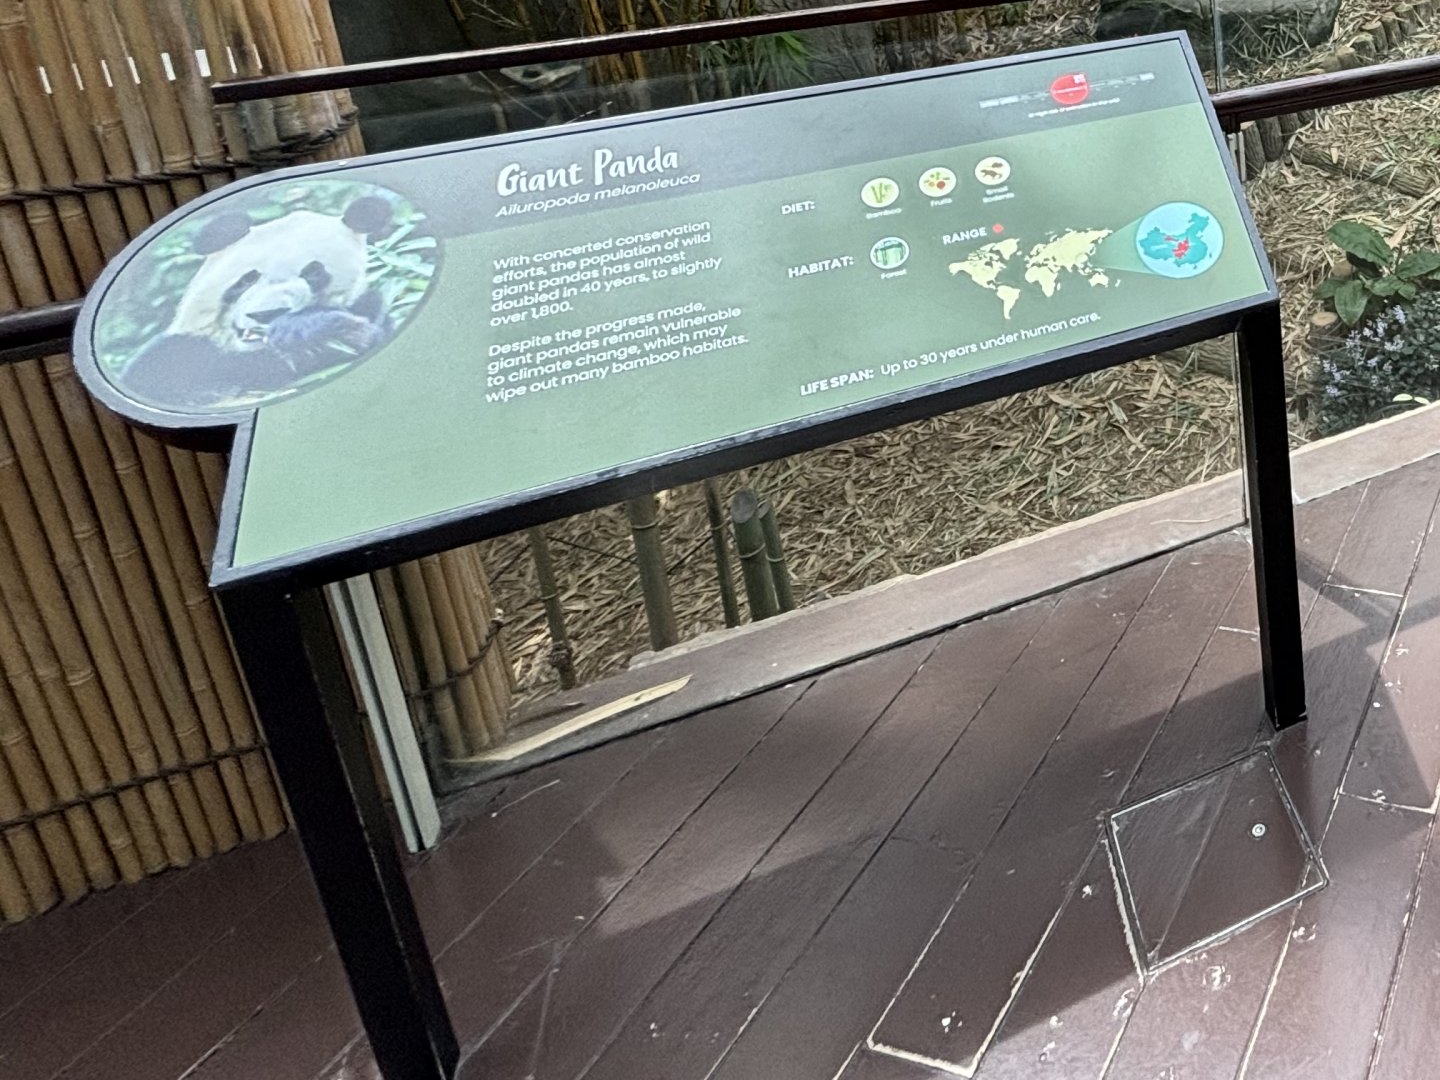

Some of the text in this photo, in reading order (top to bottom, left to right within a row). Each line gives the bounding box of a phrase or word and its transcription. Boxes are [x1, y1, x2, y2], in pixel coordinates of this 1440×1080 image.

[495, 173, 701, 217] Ailuropoda melanoleuca
[497, 146, 678, 196] Giant Panda
[781, 200, 815, 215] DIET:
[492, 233, 711, 284] efforts, the population of wild
[493, 221, 711, 270] With concerted conservation
[942, 226, 988, 245] RANGE
[491, 257, 722, 312] doubled in 40 years, to slightly
[492, 251, 685, 301] giant pandas has almost
[788, 255, 854, 278] HABITAT:
[488, 302, 706, 357] Despite the progress made,
[490, 301, 574, 327] over 1,800.
[487, 324, 728, 387] to climate change, which may
[488, 306, 742, 374] giant pandas remain vulnerable
[880, 363, 901, 377] Up
[903, 358, 918, 370] to
[920, 352, 937, 365] 30
[939, 343, 978, 363] years
[980, 332, 1019, 350] under
[1020, 320, 1068, 341] human
[1069, 312, 1102, 328] care.
[486, 334, 749, 403] wipe out many bamboo habitats.
